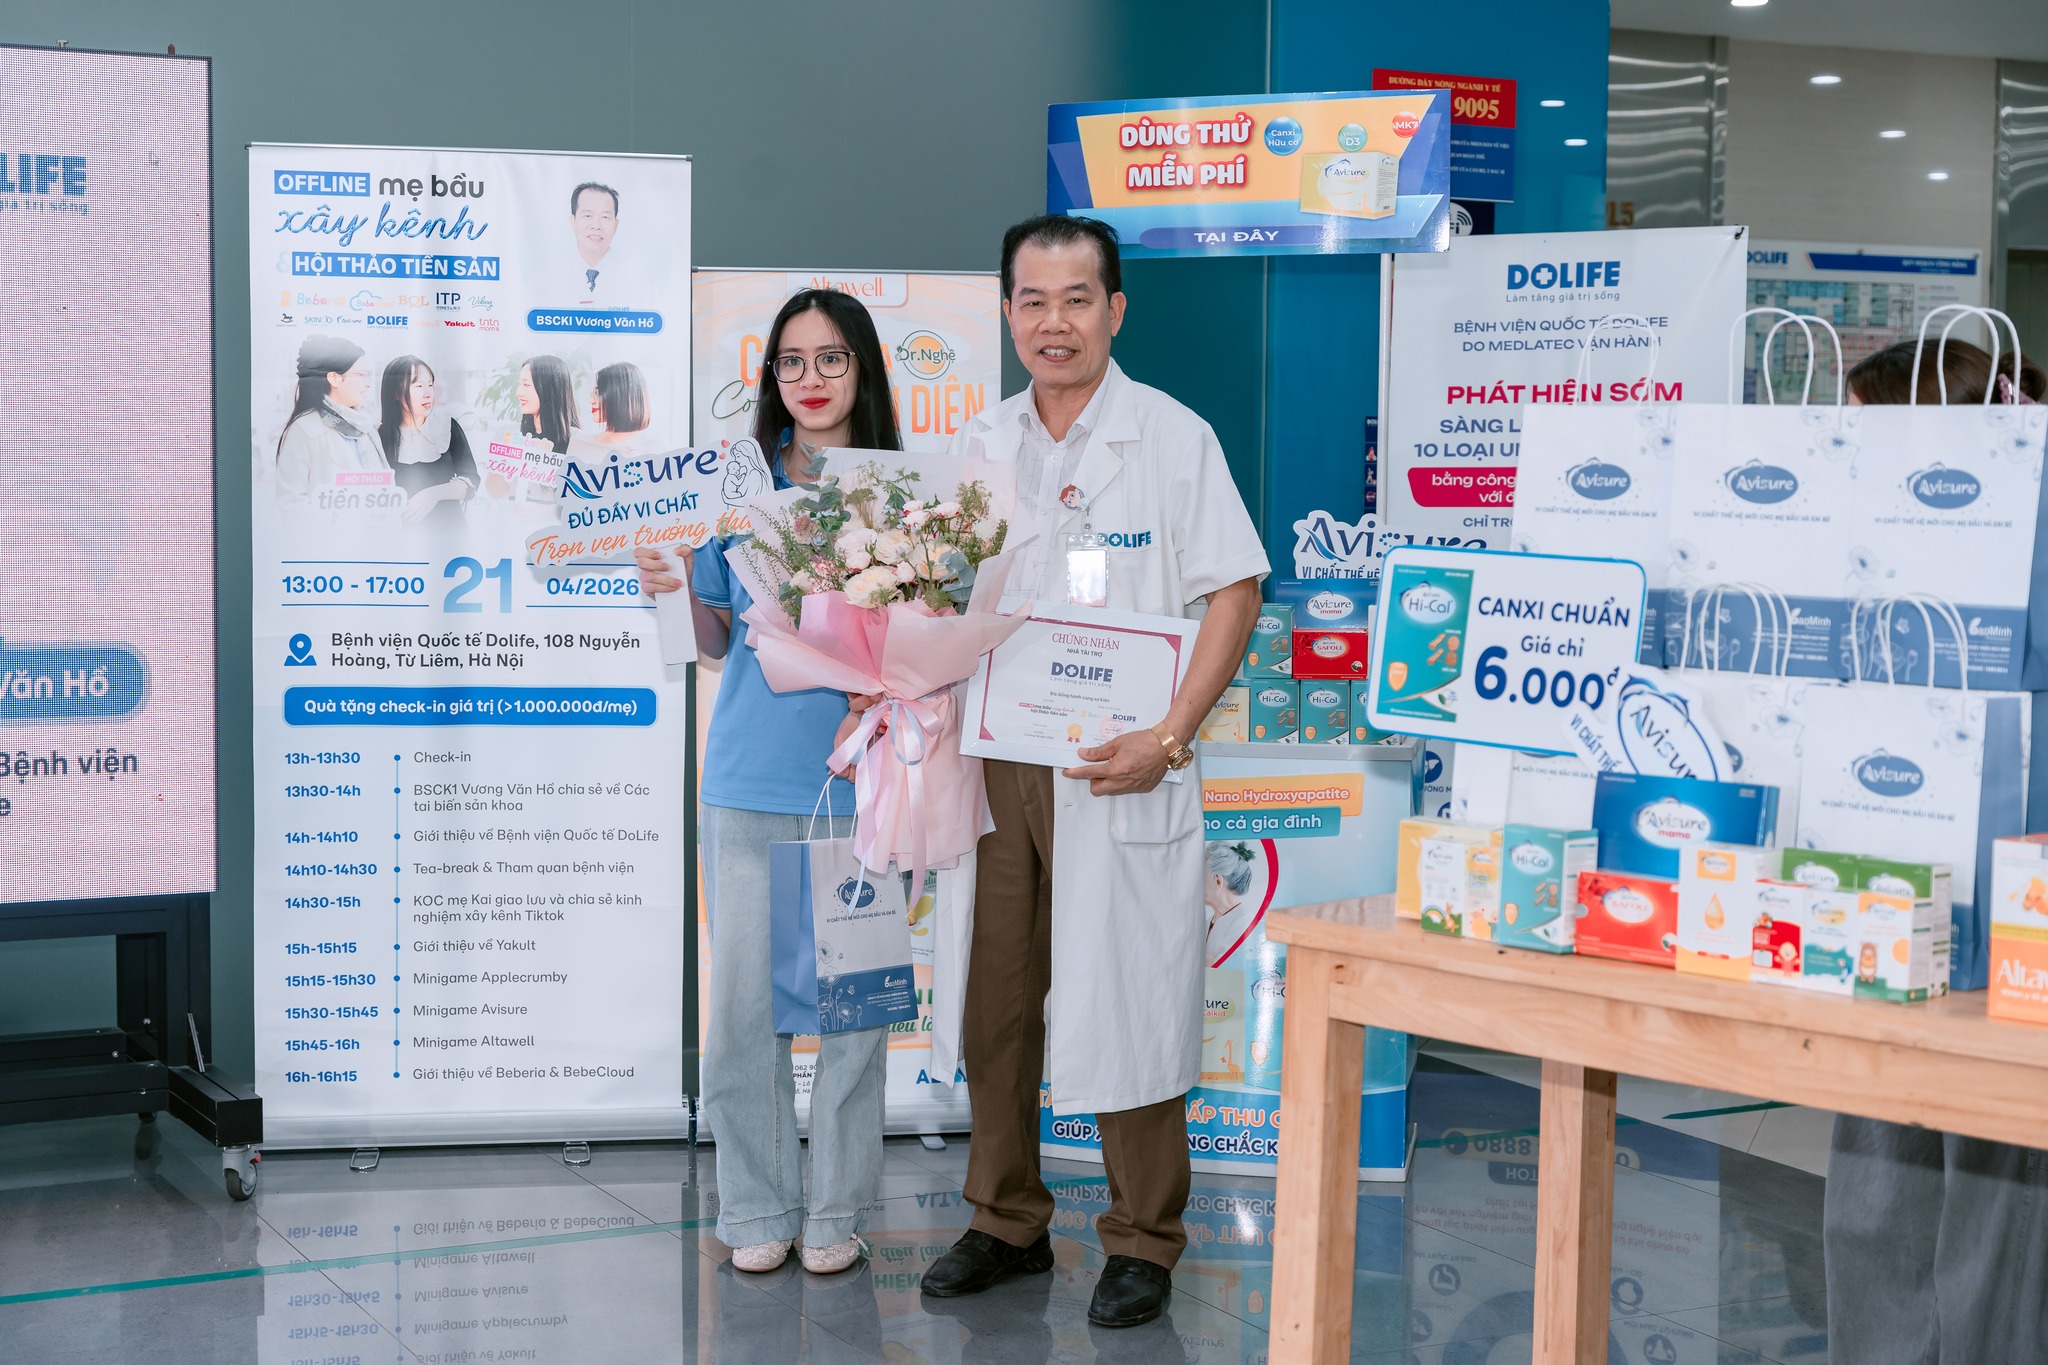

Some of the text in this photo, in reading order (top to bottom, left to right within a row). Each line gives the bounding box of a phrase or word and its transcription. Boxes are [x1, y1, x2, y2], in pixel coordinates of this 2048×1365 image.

[1418, 77, 1433, 87] DÂY
[1435, 78, 1455, 88] NÓNG
[1457, 81, 1483, 91] NGÀNH
[1484, 84, 1490, 92] Y
[1492, 83, 1501, 92] TẾ
[1454, 97, 1499, 120] 9095
[1120, 112, 1253, 149] DÙNG THỬ
[1271, 129, 1295, 137] Canxi
[1395, 121, 1417, 130] MK7
[1268, 137, 1299, 147] Hữu cơ
[1346, 137, 1360, 147] D3
[1128, 152, 1246, 188] MIỄN PHÍ
[278, 173, 485, 201] OFFLINE mẹ bầu
[275, 202, 489, 247] xây kênh
[1194, 229, 1279, 245] TẠI ĐÂY
[295, 251, 497, 277] HỘI THẢO TIỀN SẢN
[1507, 261, 1620, 289] DOLIFE
[437, 293, 461, 304] ITP
[1506, 291, 1620, 303] Làm tăng giá trị sống
[368, 316, 408, 325] DOLIFE
[536, 315, 654, 328] BSCKI Vương Văn Hồ
[1454, 319, 1497, 335] BỆNH
[1500, 318, 1536, 335] VIỆN
[1540, 316, 1585, 331] QUỐC
[1463, 340, 1485, 352] DO
[1488, 339, 1574, 351] MEDLATEC
[1577, 337, 1610, 351] VẬN
[896, 348, 956, 364] Dr.Nghệ
[1447, 378, 1682, 406] PHÁT HIỆN SỚM
[1440, 416, 1504, 433] SÀNG
[1414, 442, 1494, 461] 10 LOẠI
[559, 449, 719, 499] Avisure
[1432, 472, 1517, 488] bằng công
[1736, 476, 1794, 492] Avisure
[568, 490, 699, 529] ĐỦ ĐẦY VI CHẤT
[530, 520, 710, 565] Trọn vẹn trưởng
[282, 577, 425, 595] 13:00 17:00
[443, 557, 512, 613] 21
[546, 577, 640, 596] 04/2026
[1312, 600, 1351, 608] Avisure
[1409, 599, 1452, 613] Hi-Cal
[1478, 596, 1630, 627] CANXI CHUẨN
[332, 631, 640, 652] Bệnh viện Quốc tế Dolife, 108 Nguyễn
[1052, 633, 1120, 650] CHỨNG NHẬN
[1521, 636, 1584, 657] Giá chỉ
[1081, 648, 1090, 656] TÀI
[332, 653, 524, 670] Hoàng, Từ Liêm, Hà Nội
[1051, 662, 1113, 682] DOLIFE
[305, 699, 637, 716] Quà tặng check-in giá trị (>1.000.000đ/mẹ)
[1112, 714, 1136, 722] DOLIFE
[78, 748, 138, 781] viện
[285, 752, 360, 764] 13h-13h30
[414, 751, 471, 764] Check-in
[1862, 766, 1920, 785] Avisure
[285, 785, 361, 797] 13h30-14h
[414, 781, 650, 797] BSCK1 Vương Văn Hồ chia sẻ về Các
[1205, 788, 1349, 803] Nano Hydroxyapatite
[414, 798, 523, 812] tai biến sản khoa
[1226, 814, 1321, 832] cả gia đình
[285, 831, 358, 844] 14h-14h10
[1516, 854, 1549, 868] Hi-Cal
[285, 863, 377, 876] 14h10-14h30
[285, 896, 361, 909] 14h30-15h
[285, 942, 357, 955] 15h-15h15
[285, 974, 376, 987] 15h15-15h30
[413, 971, 567, 986] Minigame Applecrumby
[285, 1006, 378, 1019] 15h30-15h45
[413, 1004, 527, 1018] Minigame Avisure
[285, 1039, 360, 1051] 15h45-16h
[285, 1070, 357, 1083] 16h-16h15
[1053, 1119, 1092, 1141] GIÚP
[1213, 1130, 1264, 1154] CHẮC
